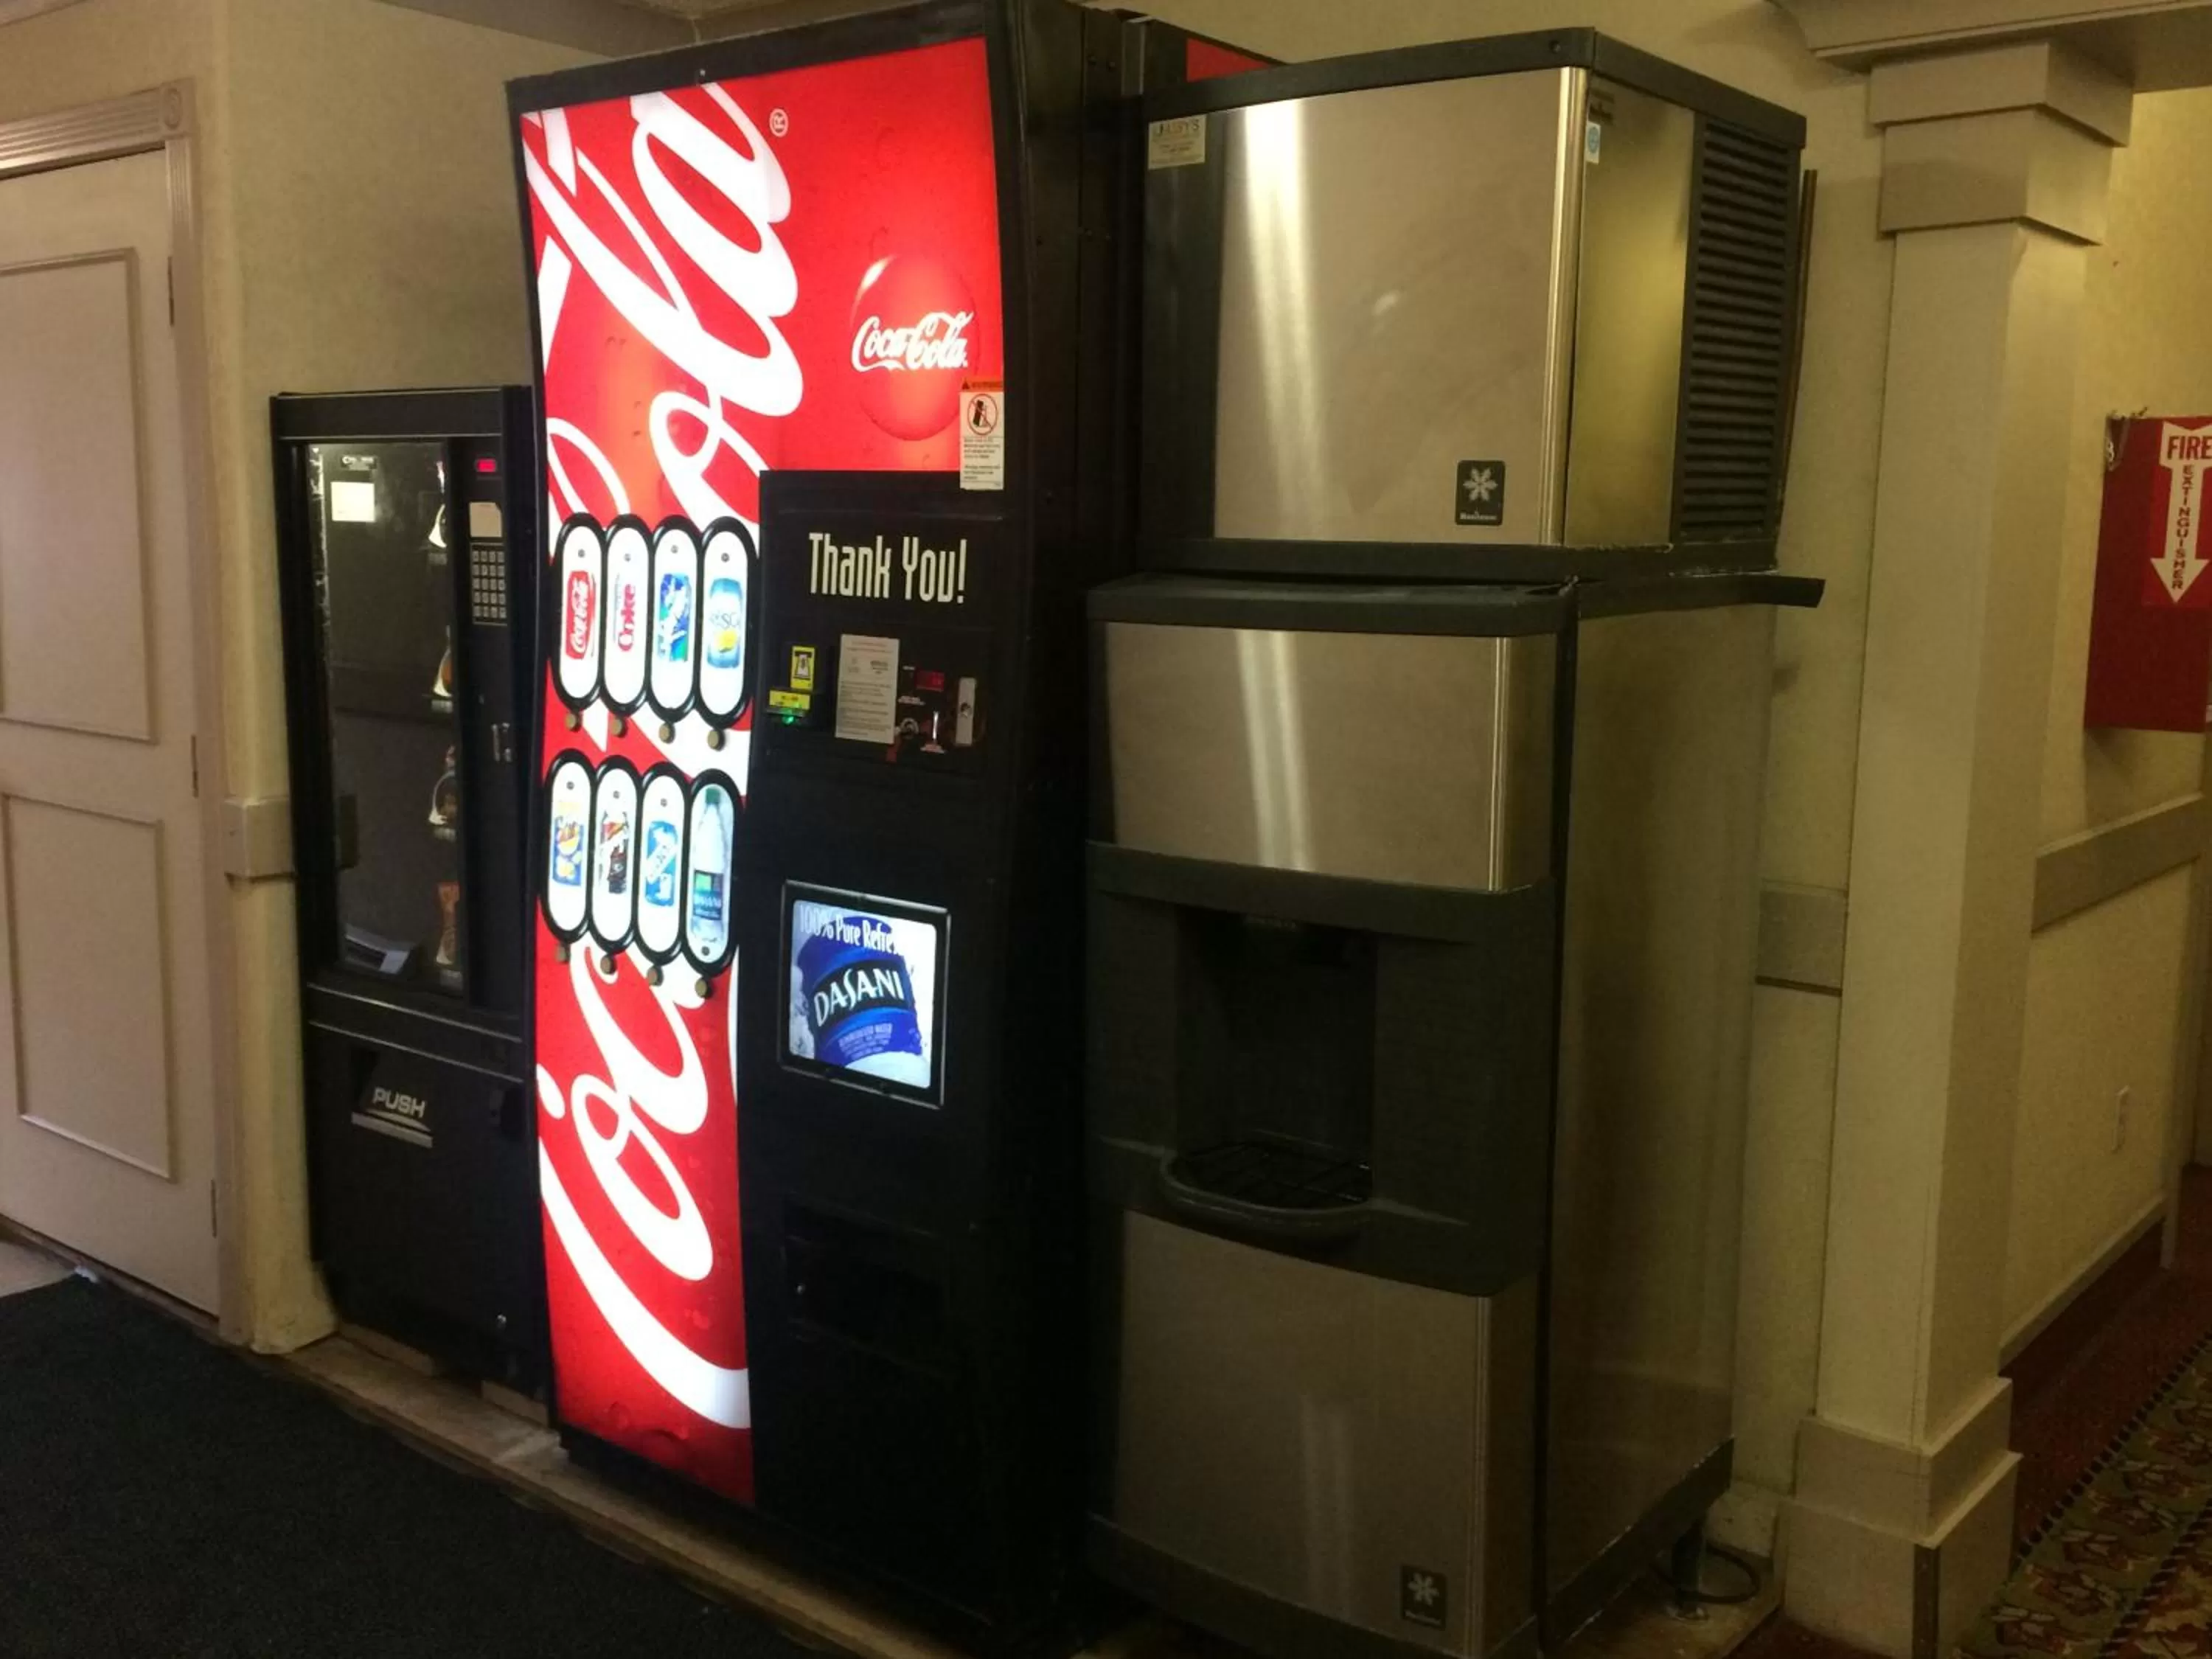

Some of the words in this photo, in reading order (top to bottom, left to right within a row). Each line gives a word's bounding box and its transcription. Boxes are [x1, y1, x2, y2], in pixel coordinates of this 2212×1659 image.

[852, 311, 973, 372] Coca-Cola
[2168, 436, 2212, 460] FIRE
[2172, 465, 2193, 590] EXTINGUISHER
[809, 533, 891, 598] Thank
[902, 536, 967, 604] You!
[521, 83, 803, 1429] CocCola
[799, 905, 834, 940] 100%
[835, 916, 861, 947] Pure
[814, 967, 904, 1027] DASANI
[372, 1086, 426, 1119] PUSH
